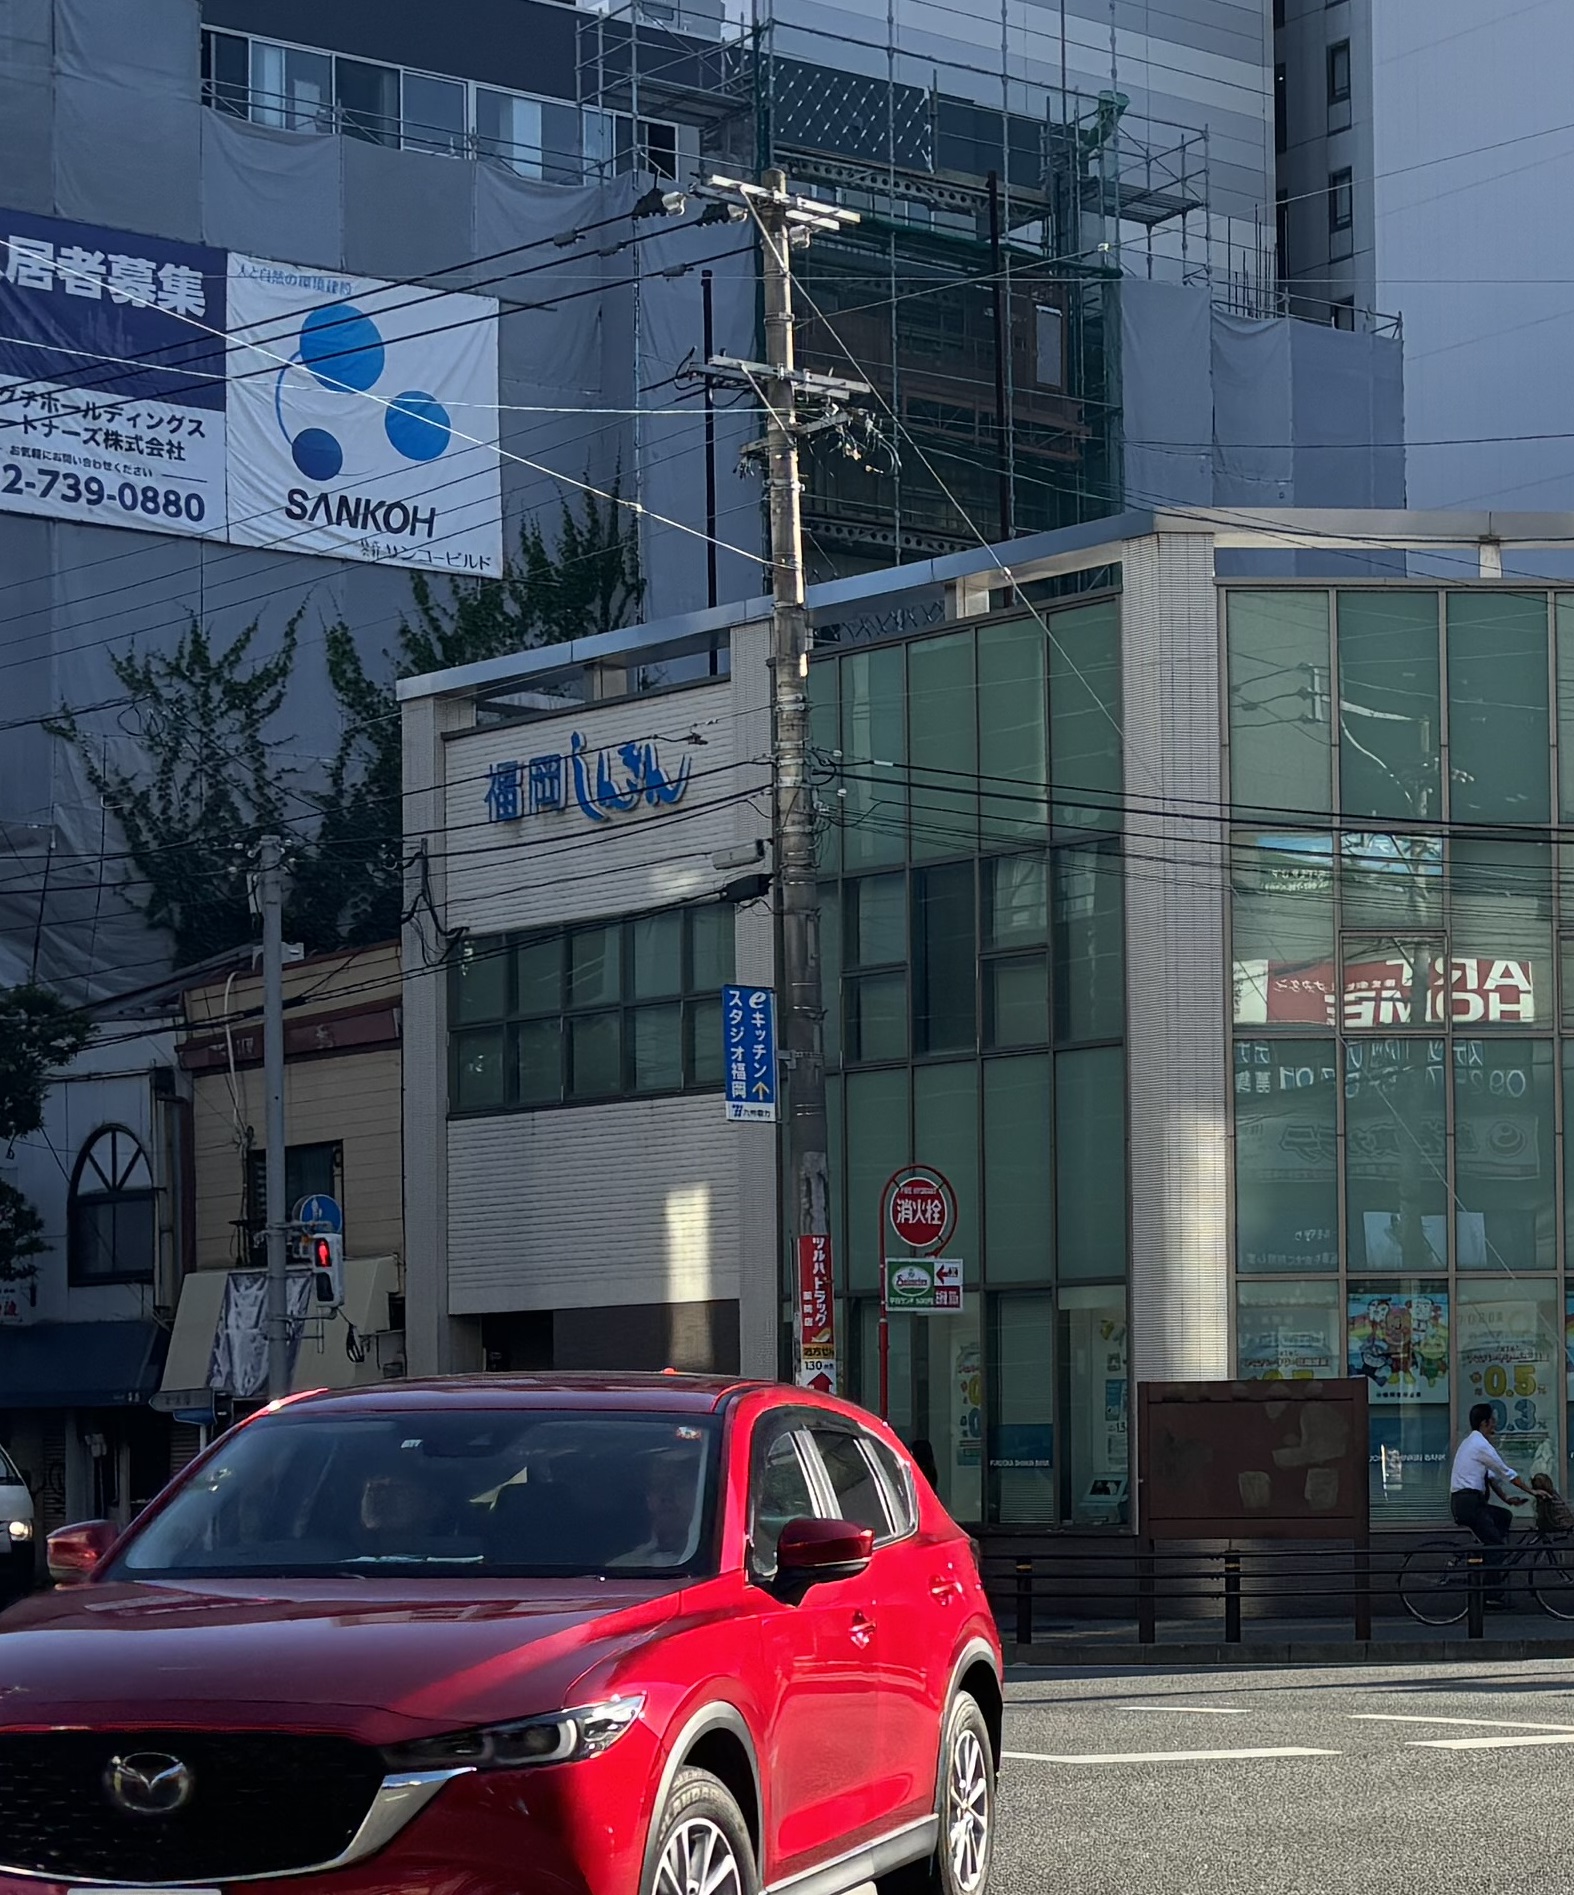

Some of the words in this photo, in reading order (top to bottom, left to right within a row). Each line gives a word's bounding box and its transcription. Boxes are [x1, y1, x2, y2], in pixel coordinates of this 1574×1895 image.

[0, 235, 206, 318] 居者募集
[1, 463, 206, 522] 2-739-0880
[285, 488, 437, 539] SANKOH
[484, 730, 691, 823] 福岡しんきん
[729, 990, 747, 1099] スタジオ福岡
[748, 990, 767, 1078] eキッチン
[896, 1198, 942, 1225] 消火栓
[812, 1237, 828, 1327] ツルハドラッグ
